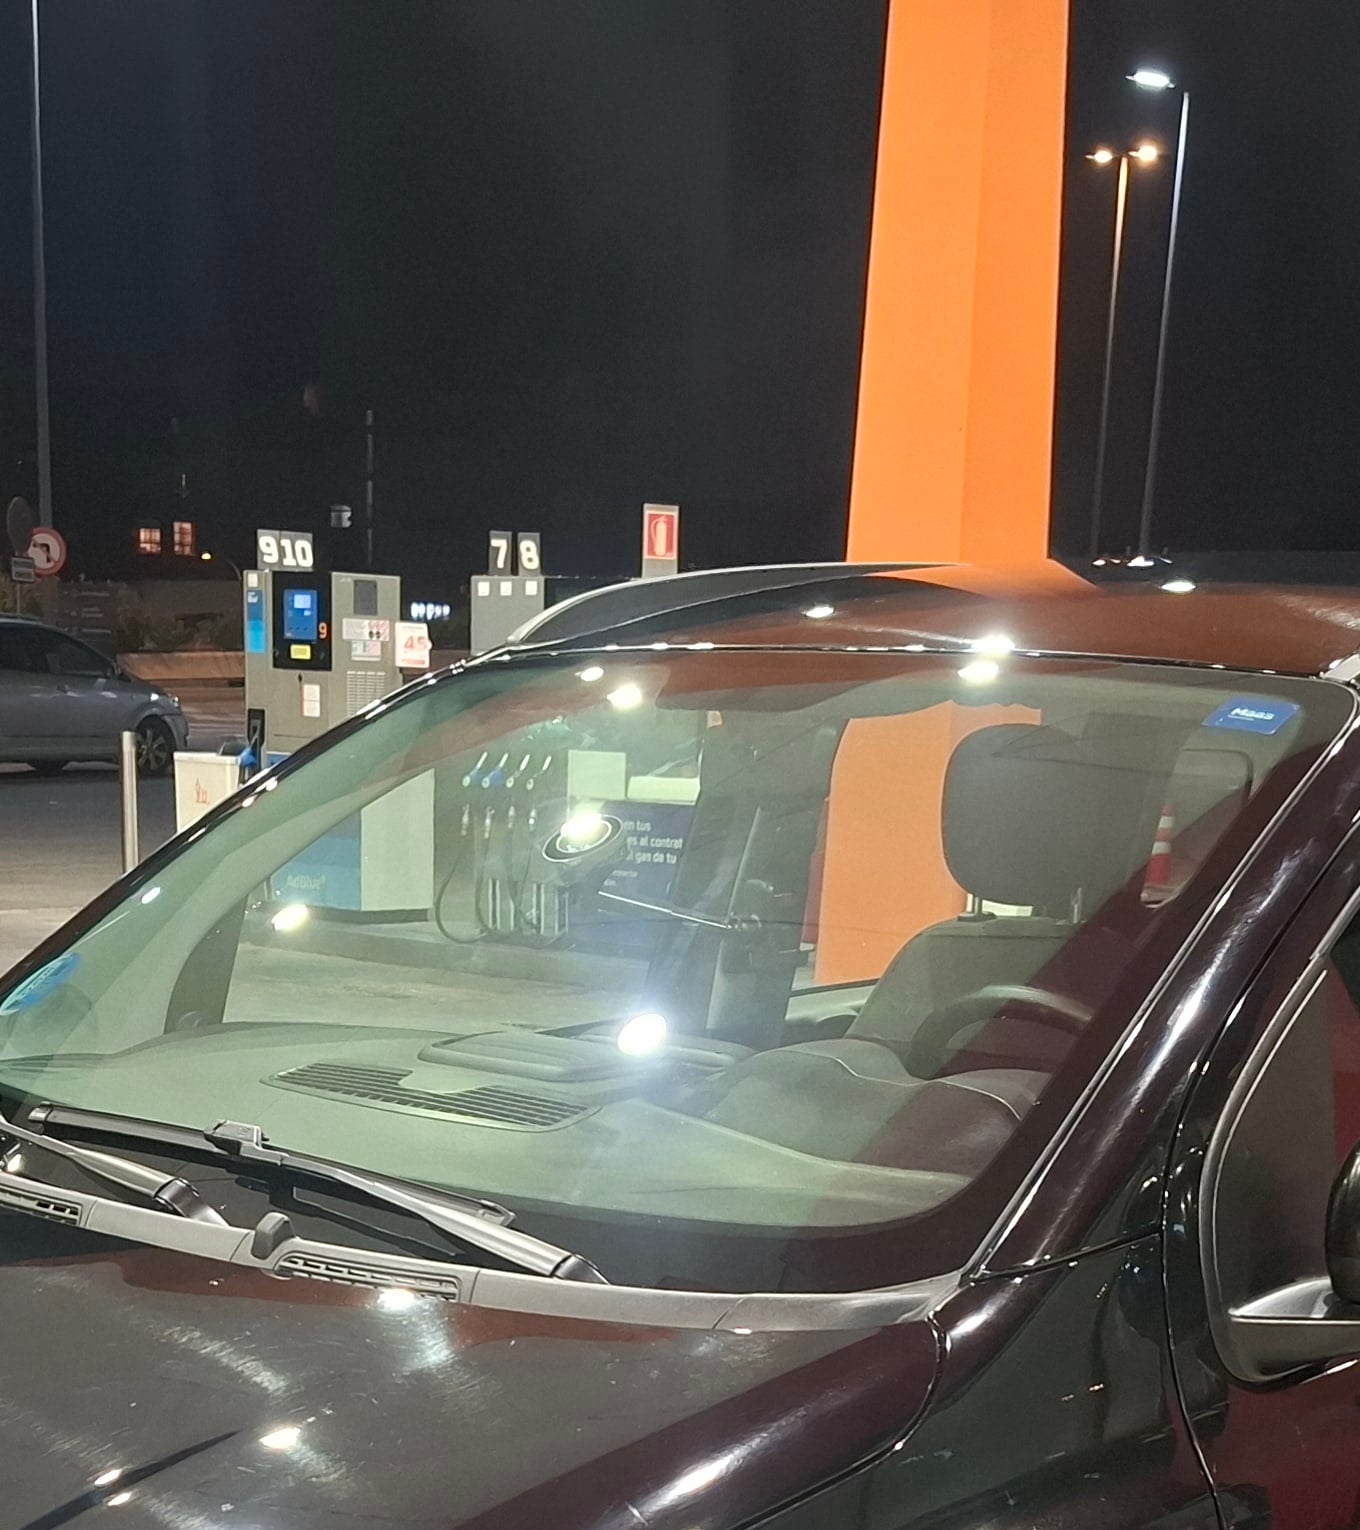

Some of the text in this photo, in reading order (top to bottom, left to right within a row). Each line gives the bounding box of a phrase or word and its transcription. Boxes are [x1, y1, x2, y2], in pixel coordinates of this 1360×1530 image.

[258, 535, 314, 568] 9 10
[490, 539, 508, 569] 7
[519, 540, 540, 570] 8
[318, 622, 328, 640] 9
[637, 819, 652, 832] tus
[653, 852, 665, 863] de
